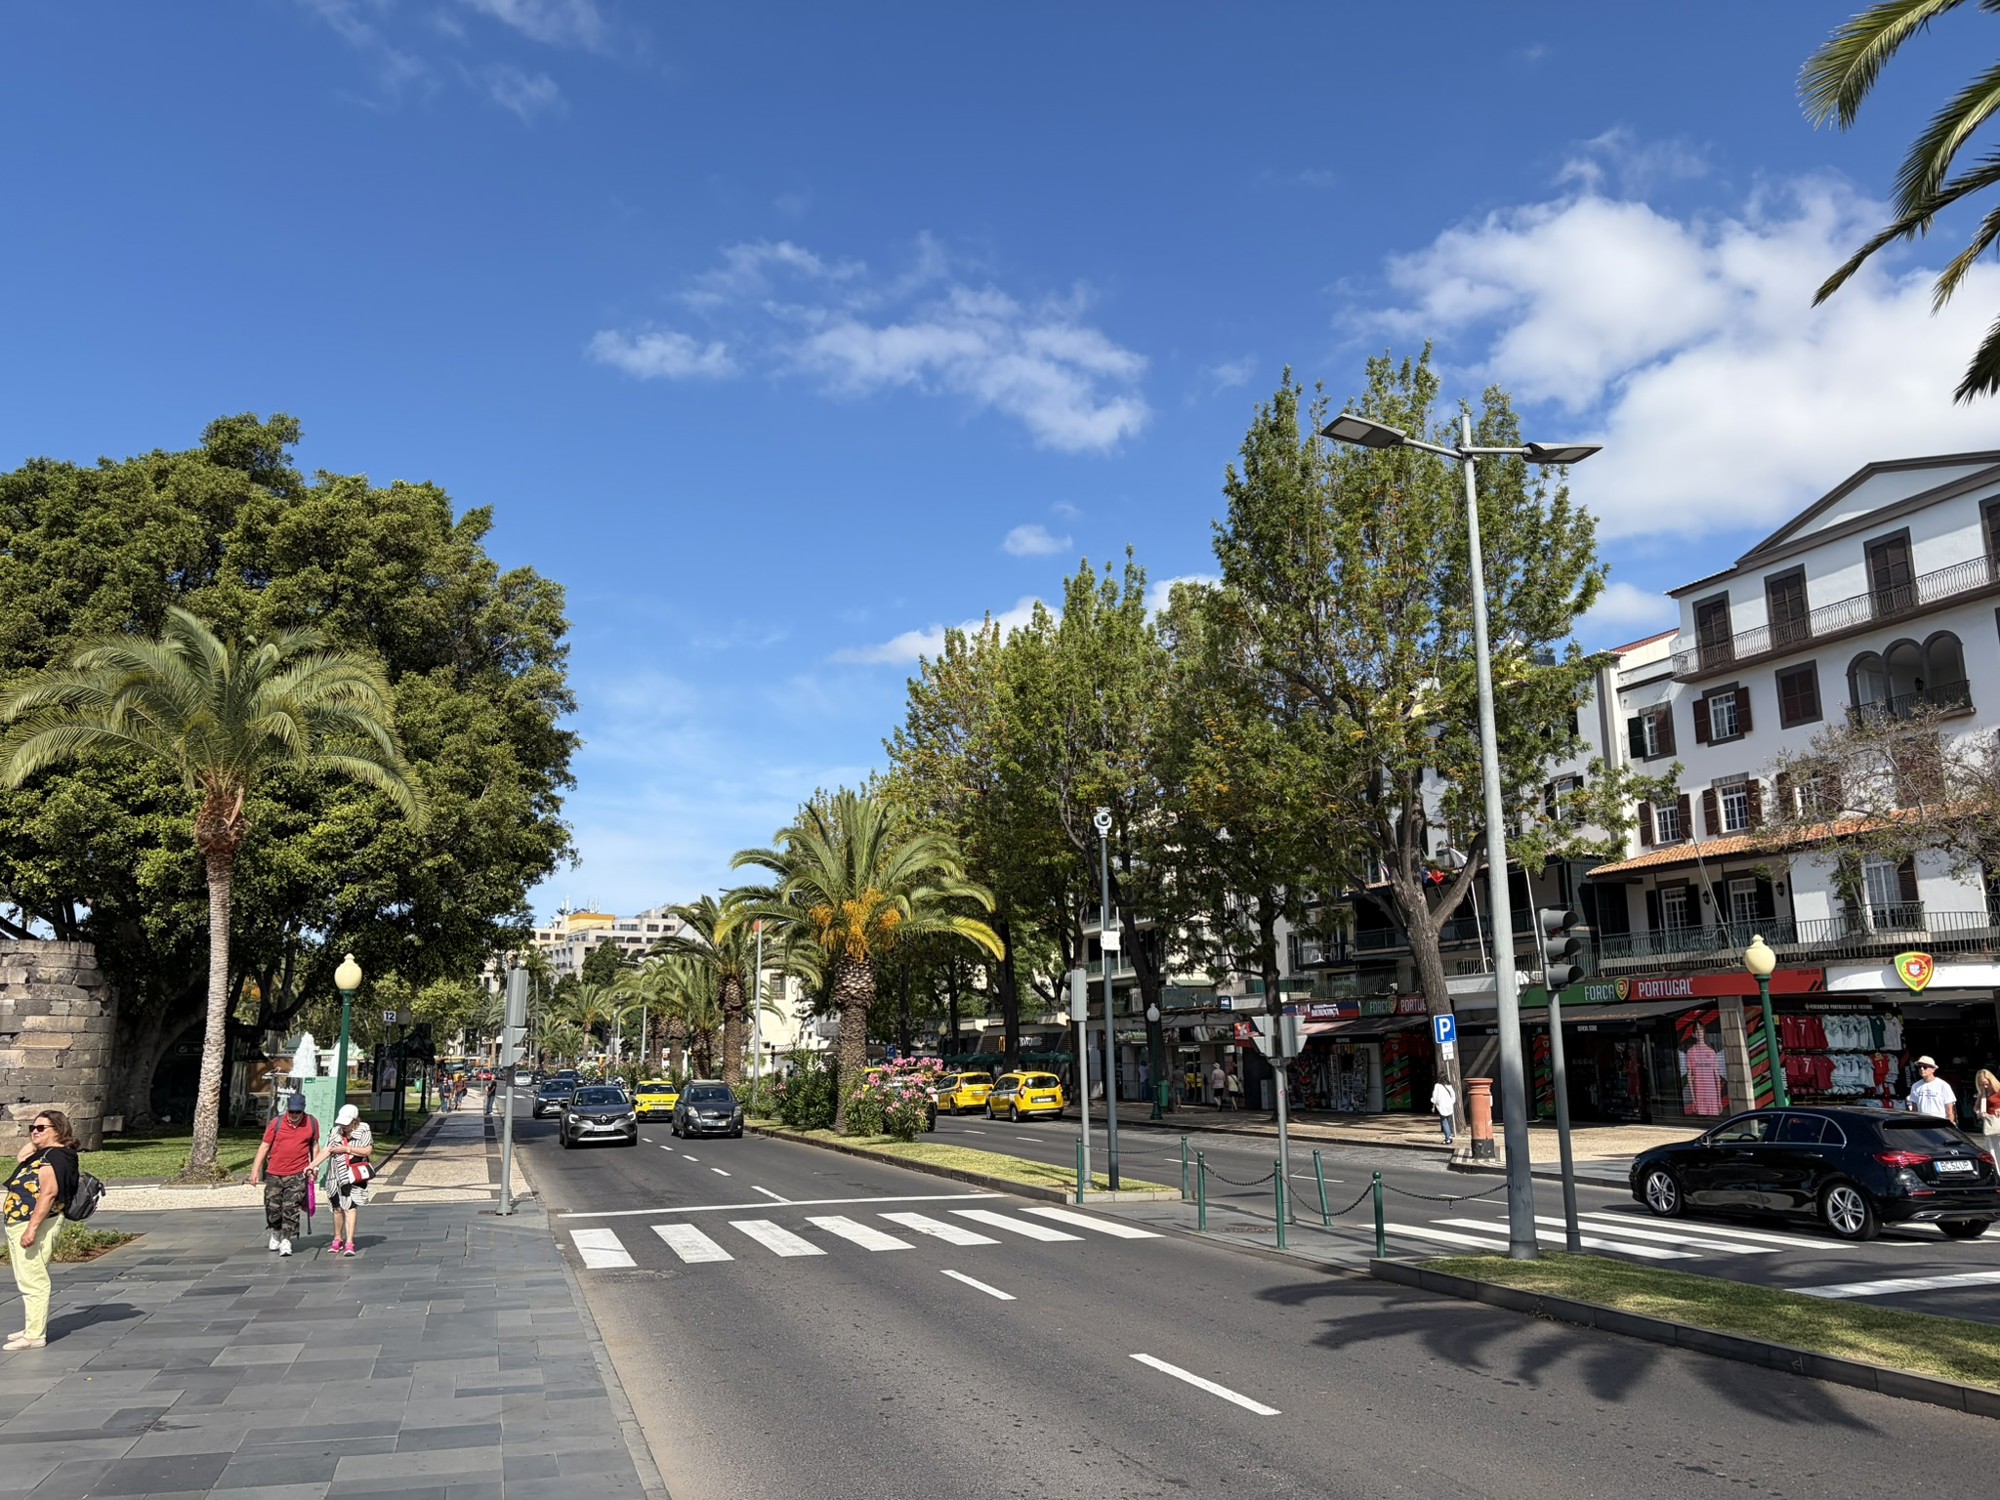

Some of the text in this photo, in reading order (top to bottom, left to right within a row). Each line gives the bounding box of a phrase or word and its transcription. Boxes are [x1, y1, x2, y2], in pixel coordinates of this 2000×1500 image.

[1638, 978, 1693, 998] PORTUGAL
[385, 1011, 395, 1020] 12
[1438, 1017, 1451, 1041] P
[1804, 1060, 1810, 1073] 7
